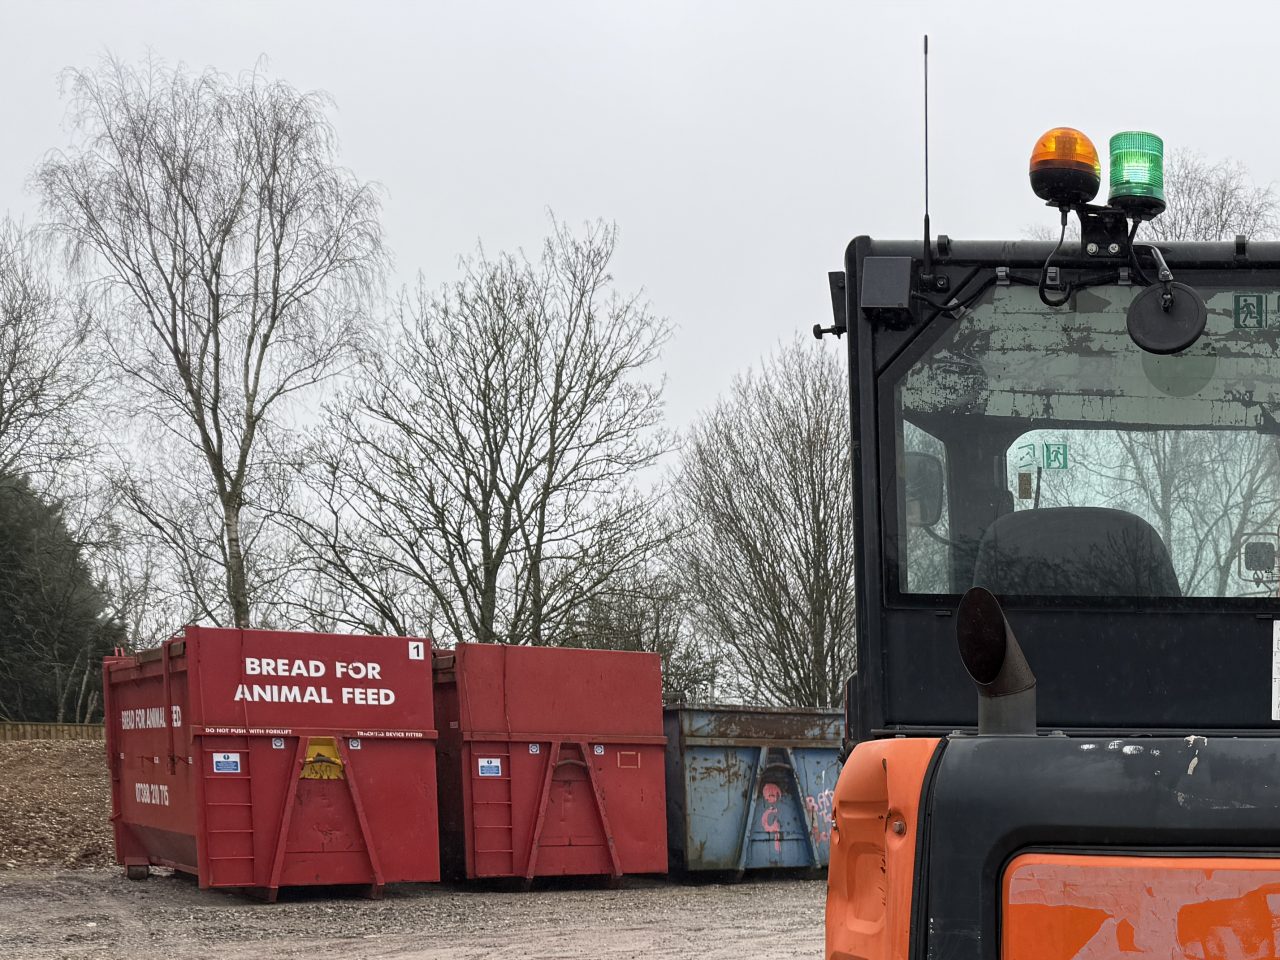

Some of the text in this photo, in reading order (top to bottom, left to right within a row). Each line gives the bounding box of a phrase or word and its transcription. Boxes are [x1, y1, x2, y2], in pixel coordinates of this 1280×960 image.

[413, 644, 420, 658] 1
[245, 657, 382, 680] BREAD FOR
[234, 684, 396, 706] ANIMAL FEED
[135, 708, 146, 729] FOR
[146, 706, 167, 729] ANIMAL
